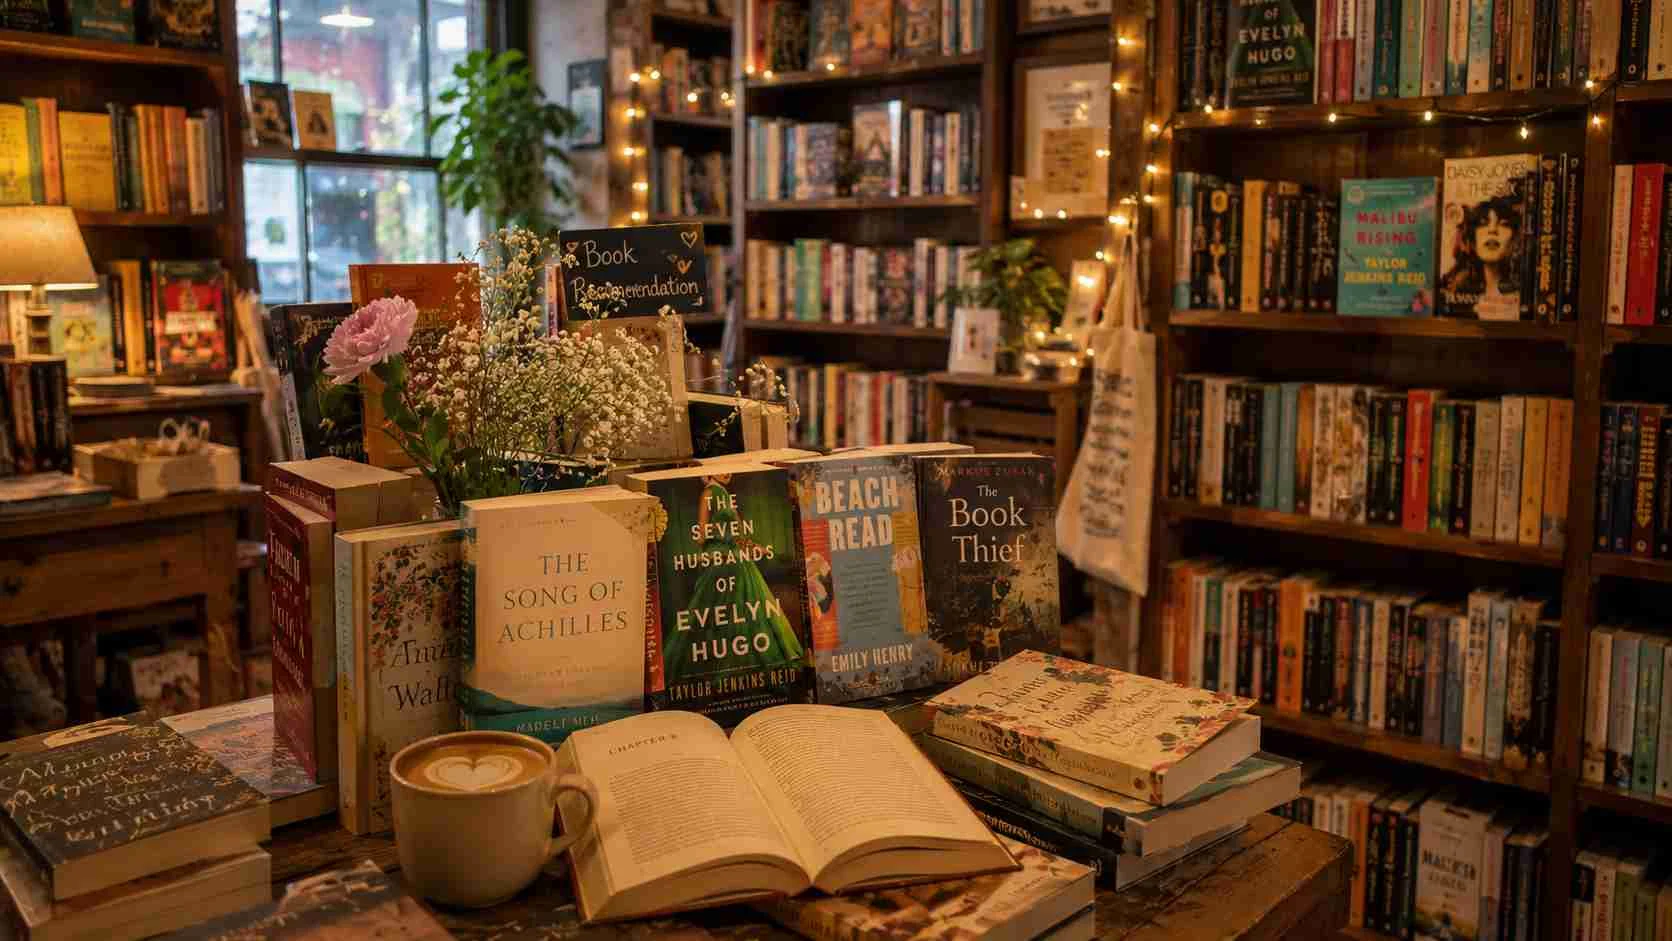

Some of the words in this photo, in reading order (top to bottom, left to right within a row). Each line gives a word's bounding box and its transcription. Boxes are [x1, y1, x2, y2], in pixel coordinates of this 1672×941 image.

[1239, 23, 1305, 43] EVELYN
[1247, 45, 1297, 64] HUGO
[1355, 209, 1417, 225] MALIBU
[1355, 231, 1417, 246] RISING
[583, 239, 639, 268] Book
[704, 493, 739, 512] THE
[816, 475, 899, 515] BEACH
[976, 484, 999, 497] The
[946, 496, 1029, 528] Book
[690, 519, 755, 541] SEVEN
[828, 513, 894, 553] READ
[673, 544, 775, 571] HUSBANDS
[951, 533, 1027, 564] Thief
[537, 551, 590, 576] THE
[502, 583, 577, 611] SONG
[588, 578, 624, 602] OF
[715, 576, 737, 593] OF
[496, 609, 628, 643] ACHILLES
[675, 597, 782, 632] EVELYN
[691, 632, 771, 663] HUGO
[831, 650, 869, 673] EMILY
[872, 642, 914, 666] HENRY
[668, 680, 712, 702] TAYLOR
[717, 671, 765, 694] JENKINS
[770, 666, 798, 685] REID
